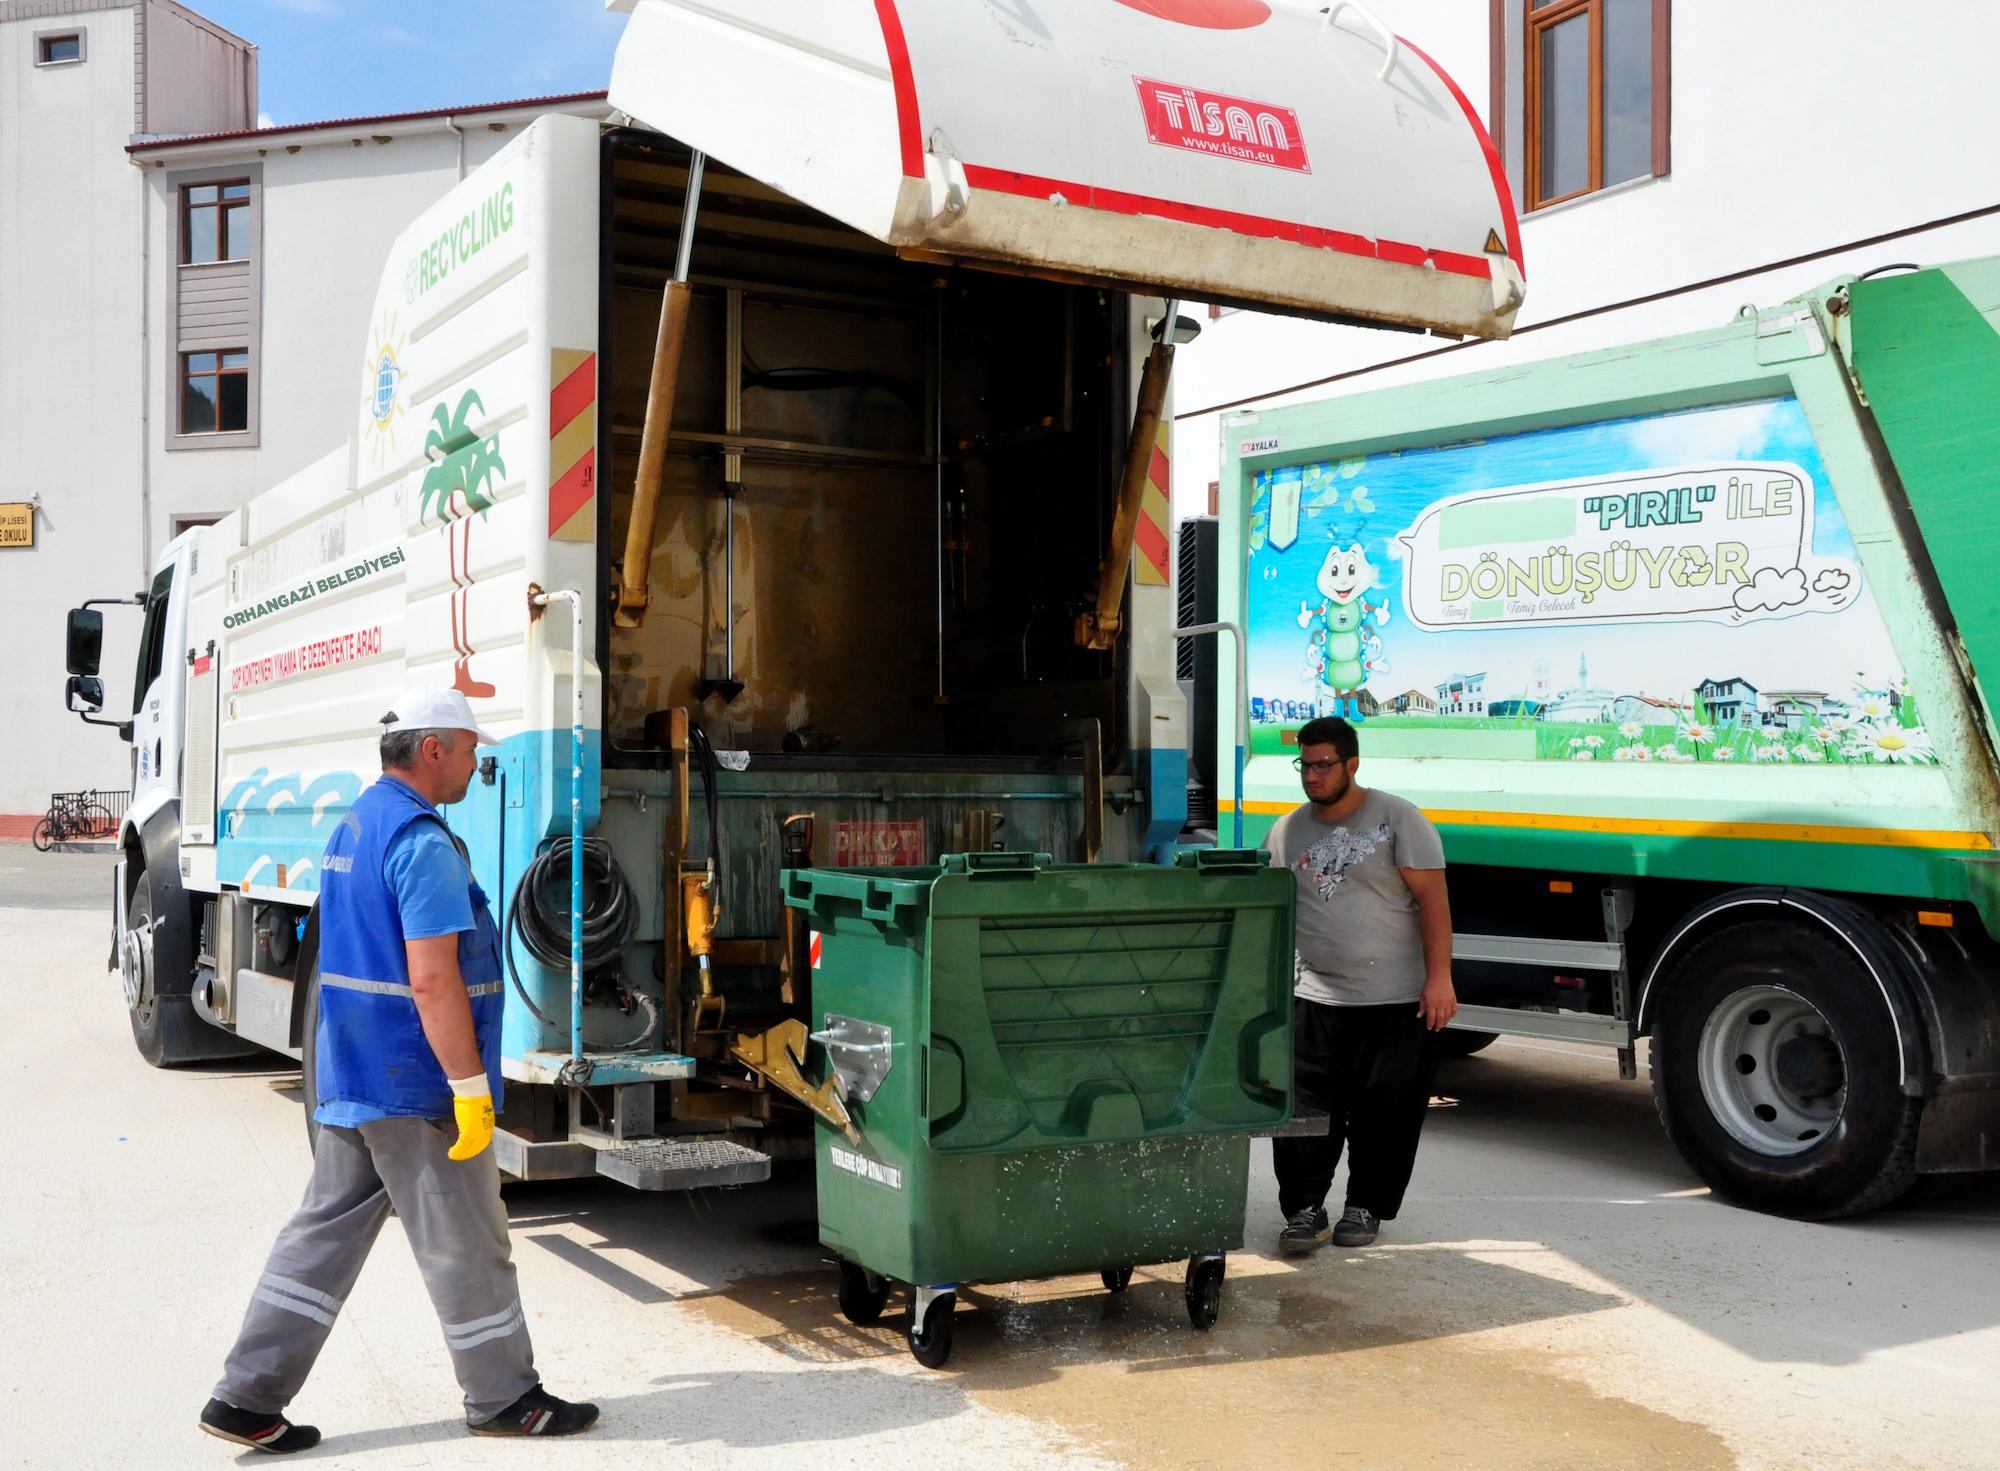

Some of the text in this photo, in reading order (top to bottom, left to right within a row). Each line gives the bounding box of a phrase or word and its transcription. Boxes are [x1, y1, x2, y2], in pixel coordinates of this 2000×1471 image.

[1182, 136, 1275, 164] www.tisan.eu
[420, 181, 514, 294] RECYCLING
[1251, 439, 1279, 452] AYALKA
[1584, 477, 1793, 531] "PIRIL" İLE
[4, 528, 27, 542] OKULU
[223, 546, 406, 629] ORHANGAZİ BELEDİYESİ
[1441, 540, 1750, 604] DÖNÜŞÜYOR
[1506, 598, 1577, 617] Temiz Gelecek
[308, 633, 354, 669] DEZENFEKTE
[356, 626, 382, 658] ARACI
